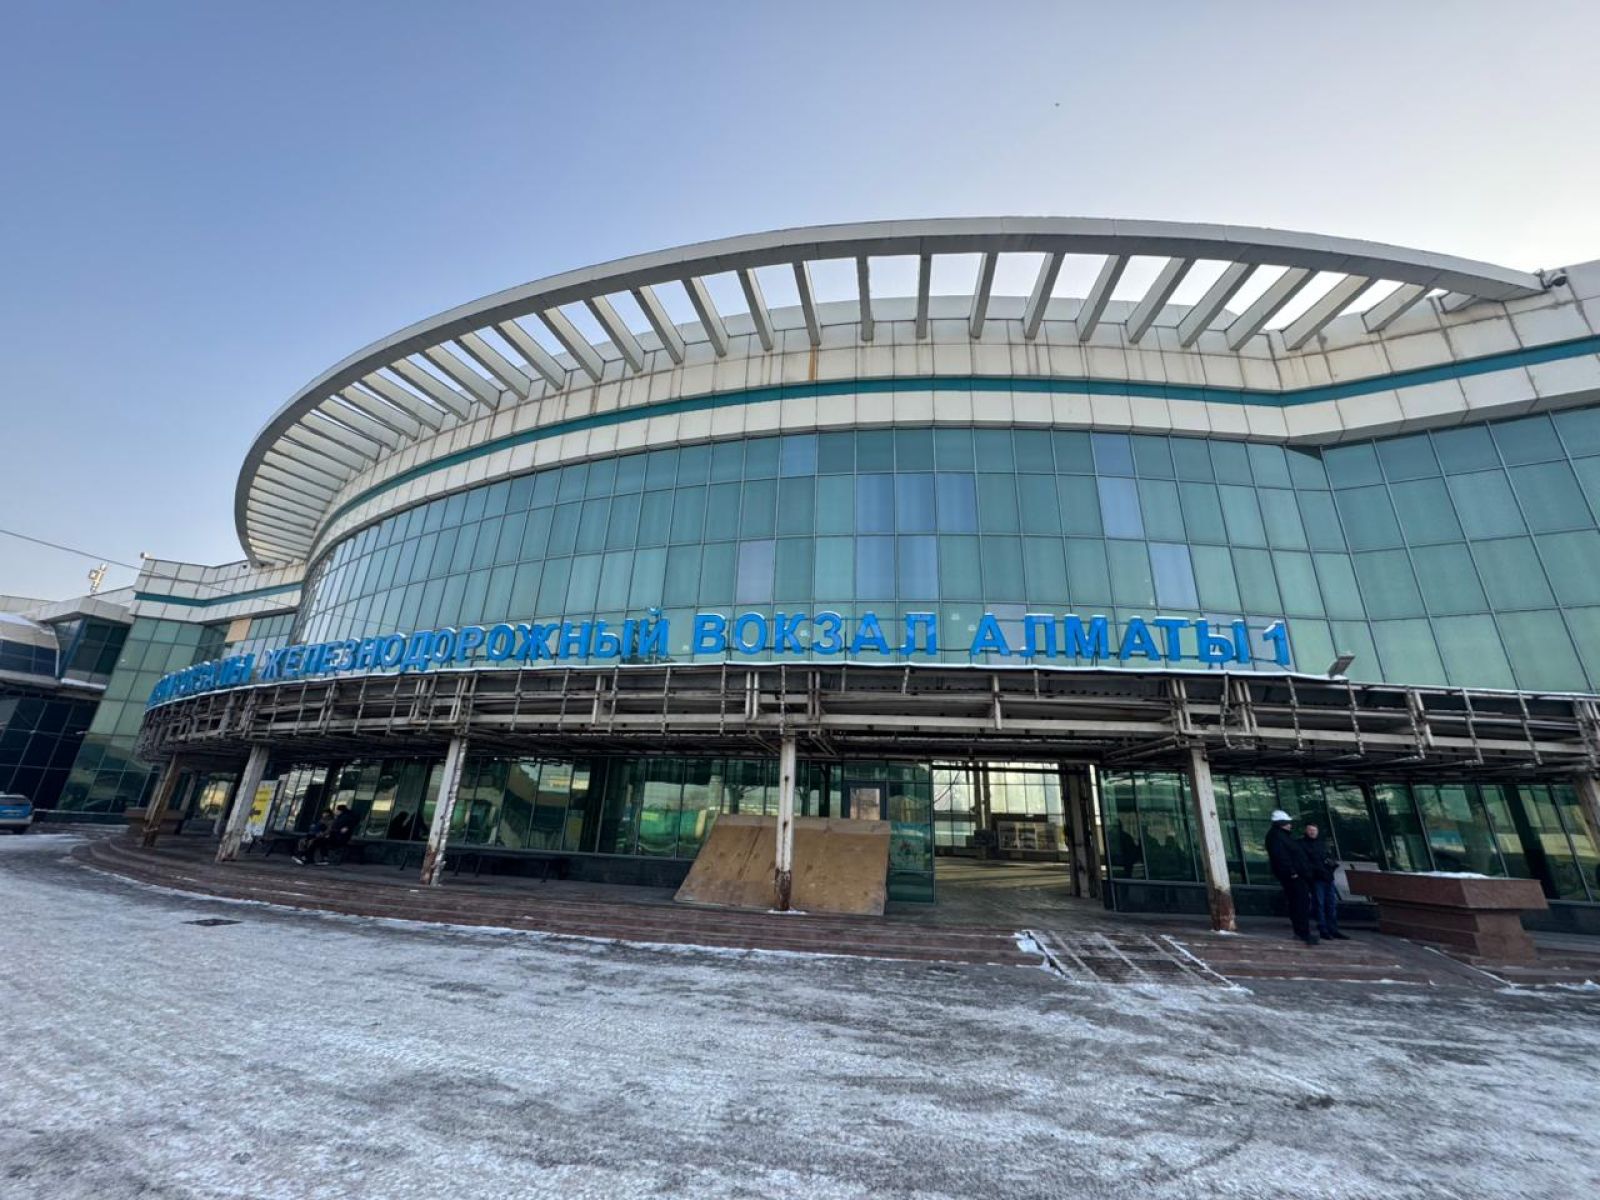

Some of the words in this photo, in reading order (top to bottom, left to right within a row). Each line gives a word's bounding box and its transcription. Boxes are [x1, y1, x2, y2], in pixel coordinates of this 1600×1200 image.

[260, 607, 670, 680] ЖЕЛЕЗНОДОРОЖНЫЙ
[693, 611, 937, 656] ВОКЗАЛ
[970, 612, 1250, 665] АЛМАТЫ
[1263, 620, 1290, 665] 1
